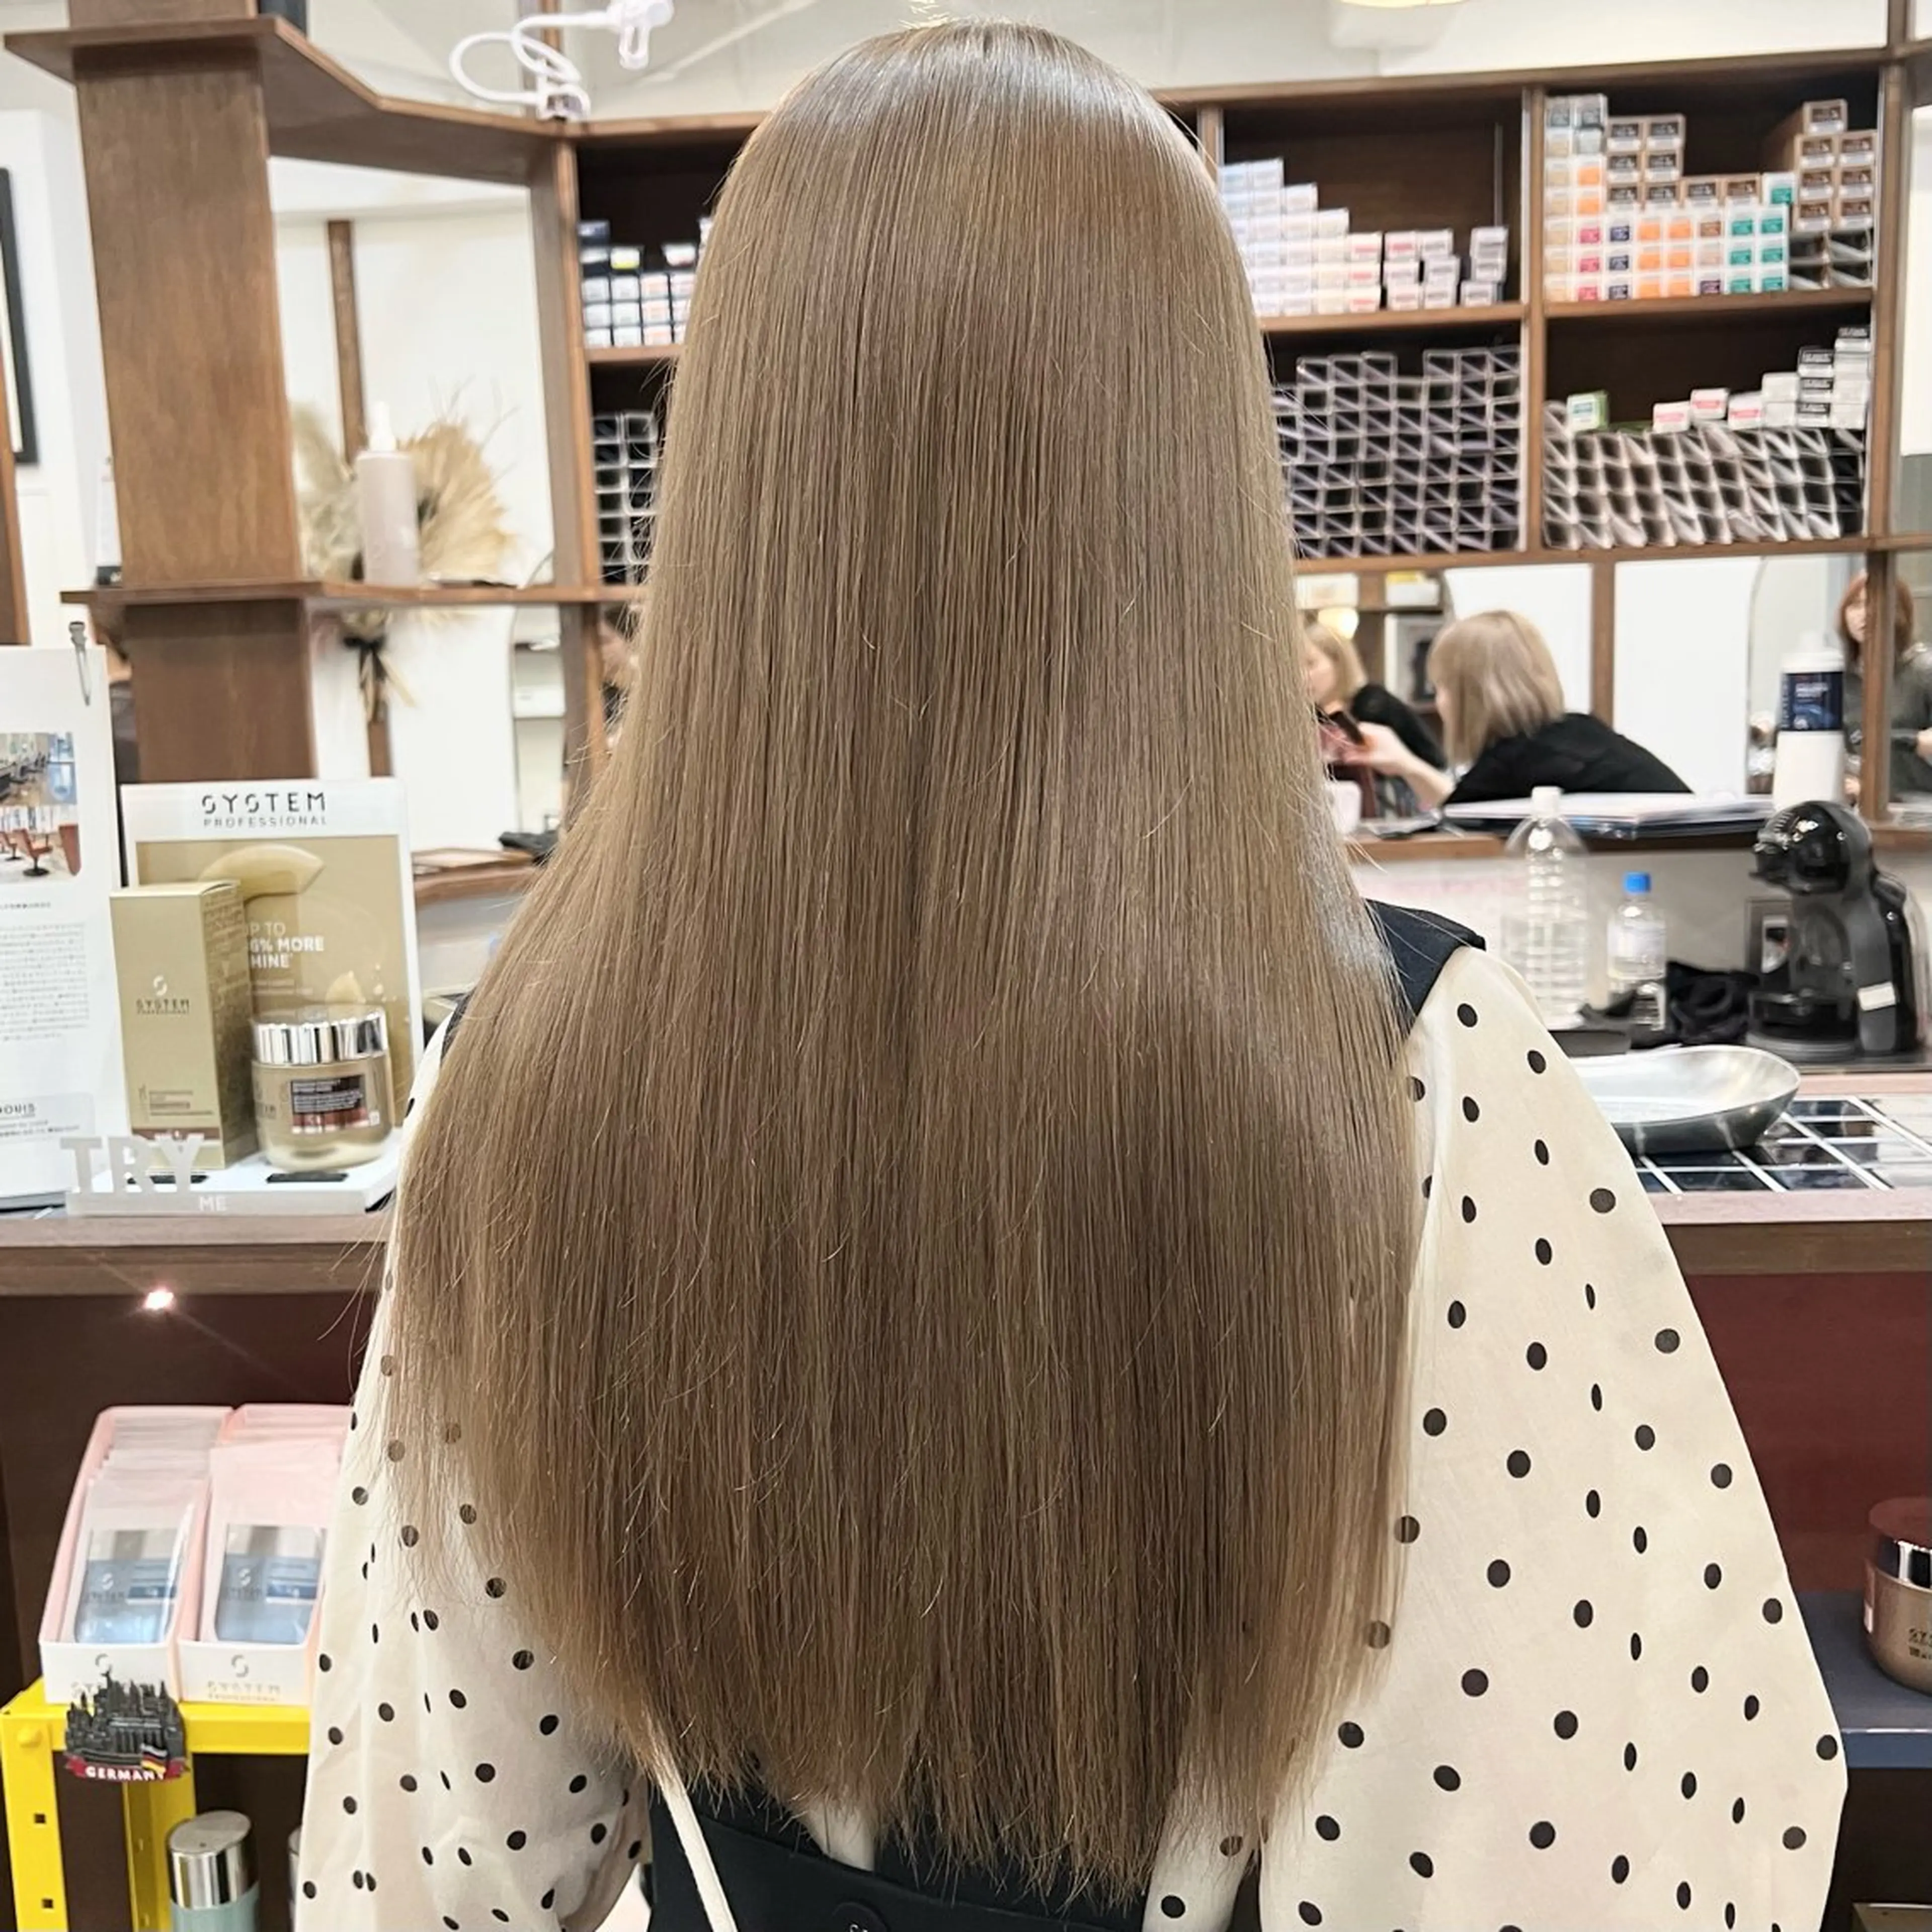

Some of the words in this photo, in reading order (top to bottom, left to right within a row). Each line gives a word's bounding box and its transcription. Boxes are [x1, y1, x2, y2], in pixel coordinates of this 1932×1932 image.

[202, 792, 326, 814] SYSTEM
[203, 815, 326, 828] PROFESSIONAL
[250, 922, 260, 936] P
[264, 922, 286, 937] TO
[277, 936, 325, 952] MORE
[59, 1132, 204, 1193] TRY
[200, 1195, 228, 1212] ME
[85, 1765, 165, 1781] GERMANY
